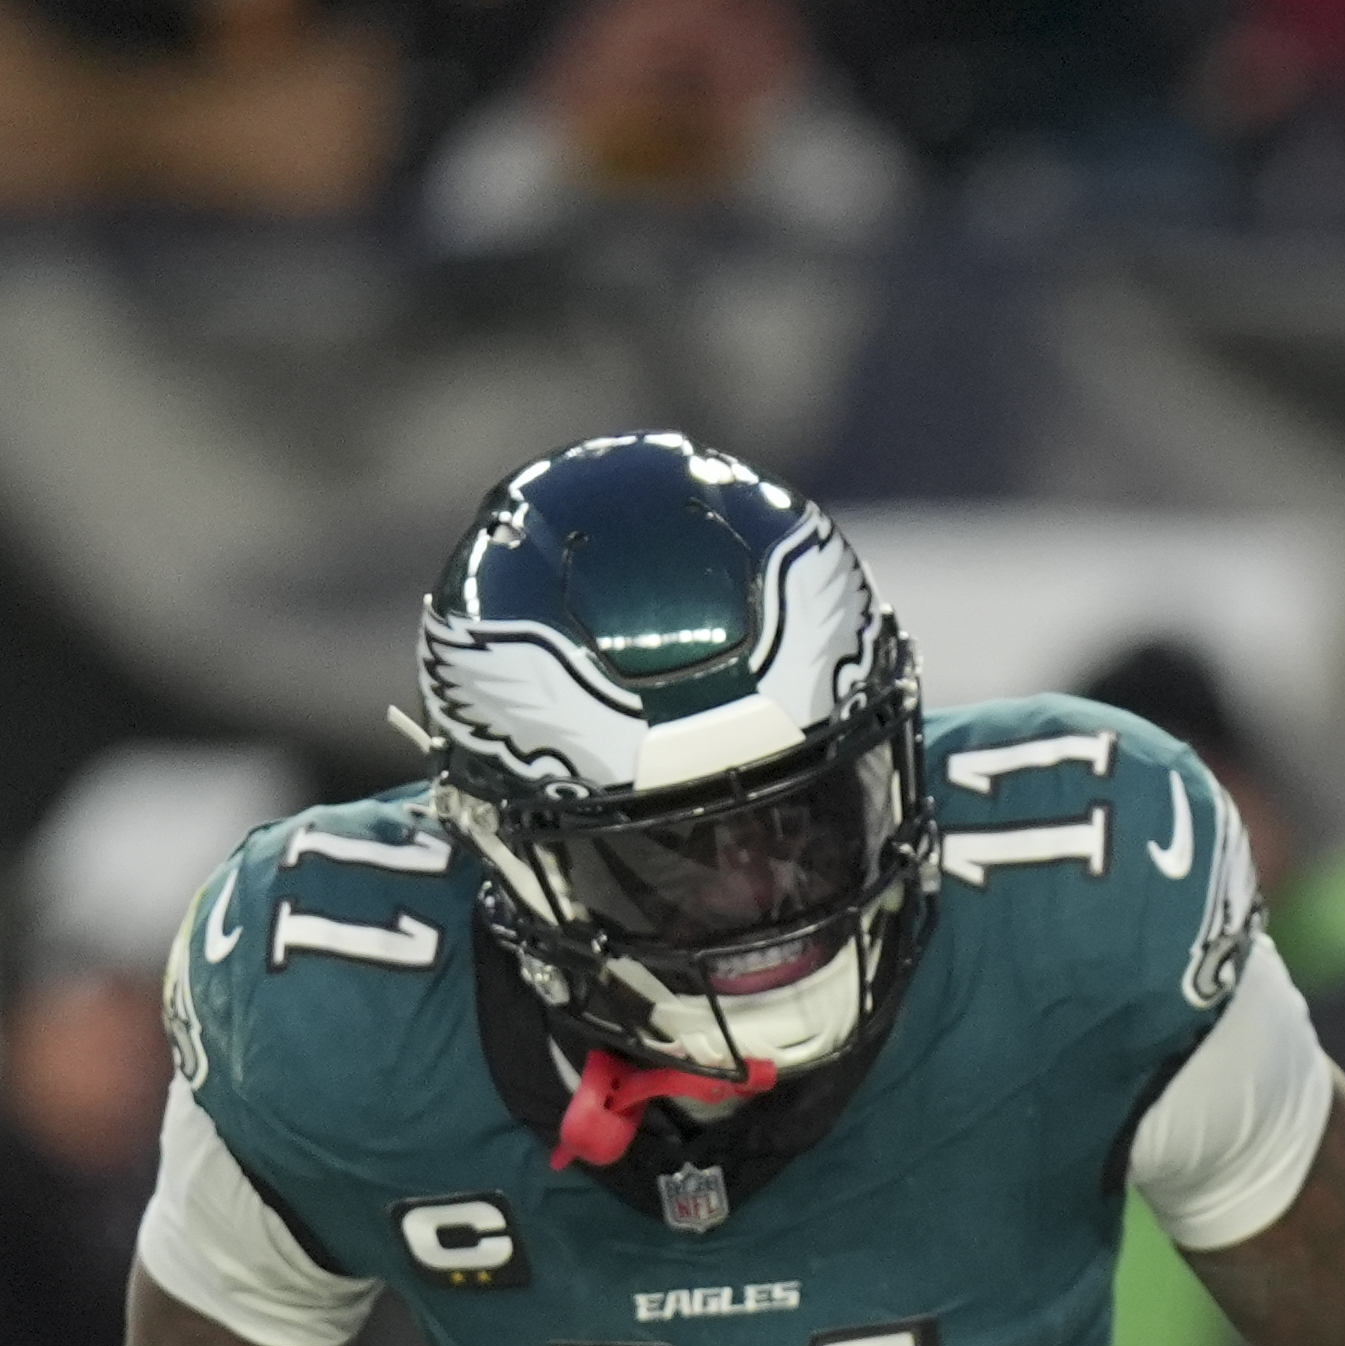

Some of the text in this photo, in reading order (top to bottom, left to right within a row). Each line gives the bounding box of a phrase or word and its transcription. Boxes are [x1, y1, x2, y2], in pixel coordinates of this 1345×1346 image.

[943, 730, 1118, 888] 11
[267, 822, 457, 972] 11
[402, 1200, 514, 1271] C
[676, 1195, 715, 1218] NFL
[633, 1281, 800, 1322] EAGLES
